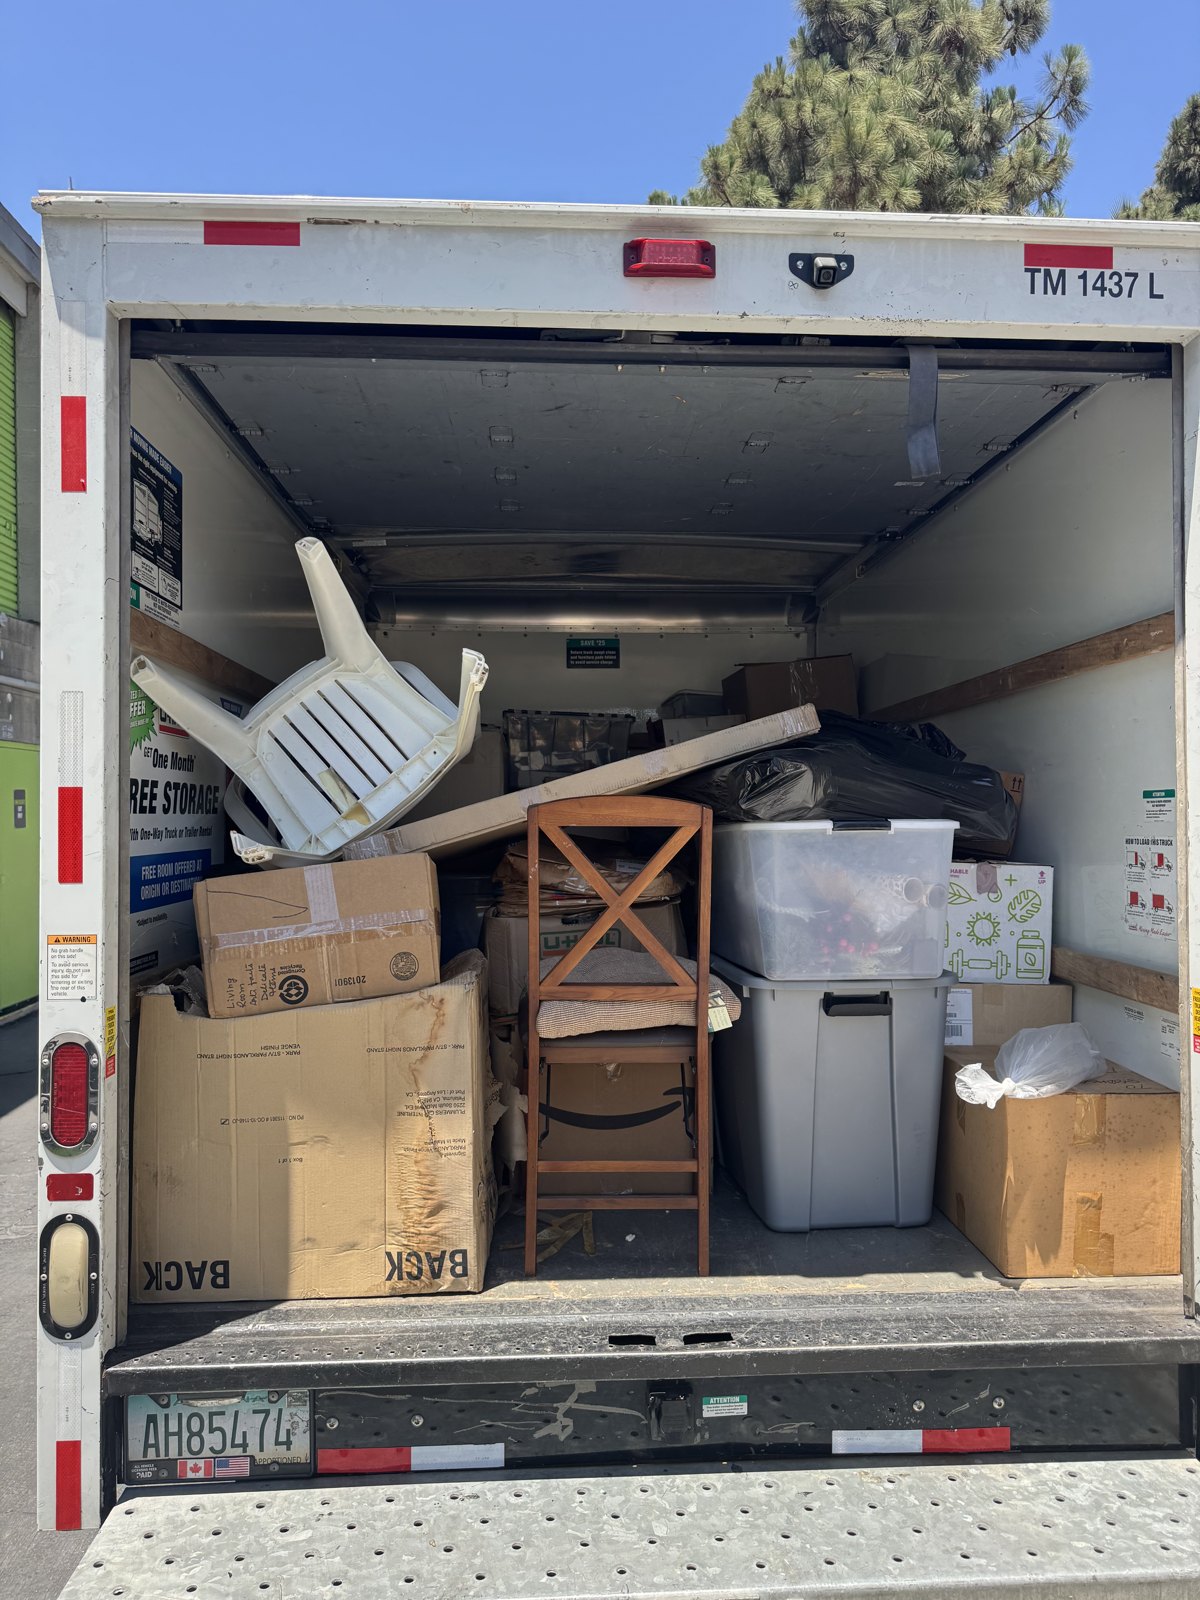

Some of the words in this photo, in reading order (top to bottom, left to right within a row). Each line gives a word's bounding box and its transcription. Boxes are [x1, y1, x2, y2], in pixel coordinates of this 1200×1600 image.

[1024, 268, 1066, 296] TM
[1078, 270, 1139, 298] 1437
[1149, 272, 1164, 299] L
[130, 700, 145, 718] FFER
[144, 747, 152, 758] GET
[152, 748, 168, 769] One
[130, 778, 159, 814] REE
[162, 781, 219, 815] STORAGE
[140, 828, 163, 841] One-Way
[165, 827, 177, 839] Truck
[179, 828, 184, 838] or
[185, 827, 198, 838] Trailer
[200, 826, 213, 836] Rental
[142, 866, 156, 880] FREE
[157, 863, 174, 878] ROOM
[174, 860, 196, 874] OFFERED
[197, 859, 202, 871] AT
[141, 884, 160, 900] ORIGIN
[162, 882, 169, 896] OR
[170, 876, 202, 893] DESTINA
[258, 964, 268, 1001] Delicate
[335, 975, 366, 986] 2013901
[227, 978, 237, 1008] Living
[236, 984, 246, 1008] Room
[143, 1260, 230, 1290] BACK
[385, 1249, 468, 1281] BACK
[710, 1396, 739, 1404] ATTENTION
[143, 1408, 292, 1458] AH85474
[255, 1456, 301, 1465] APPORTIONED
